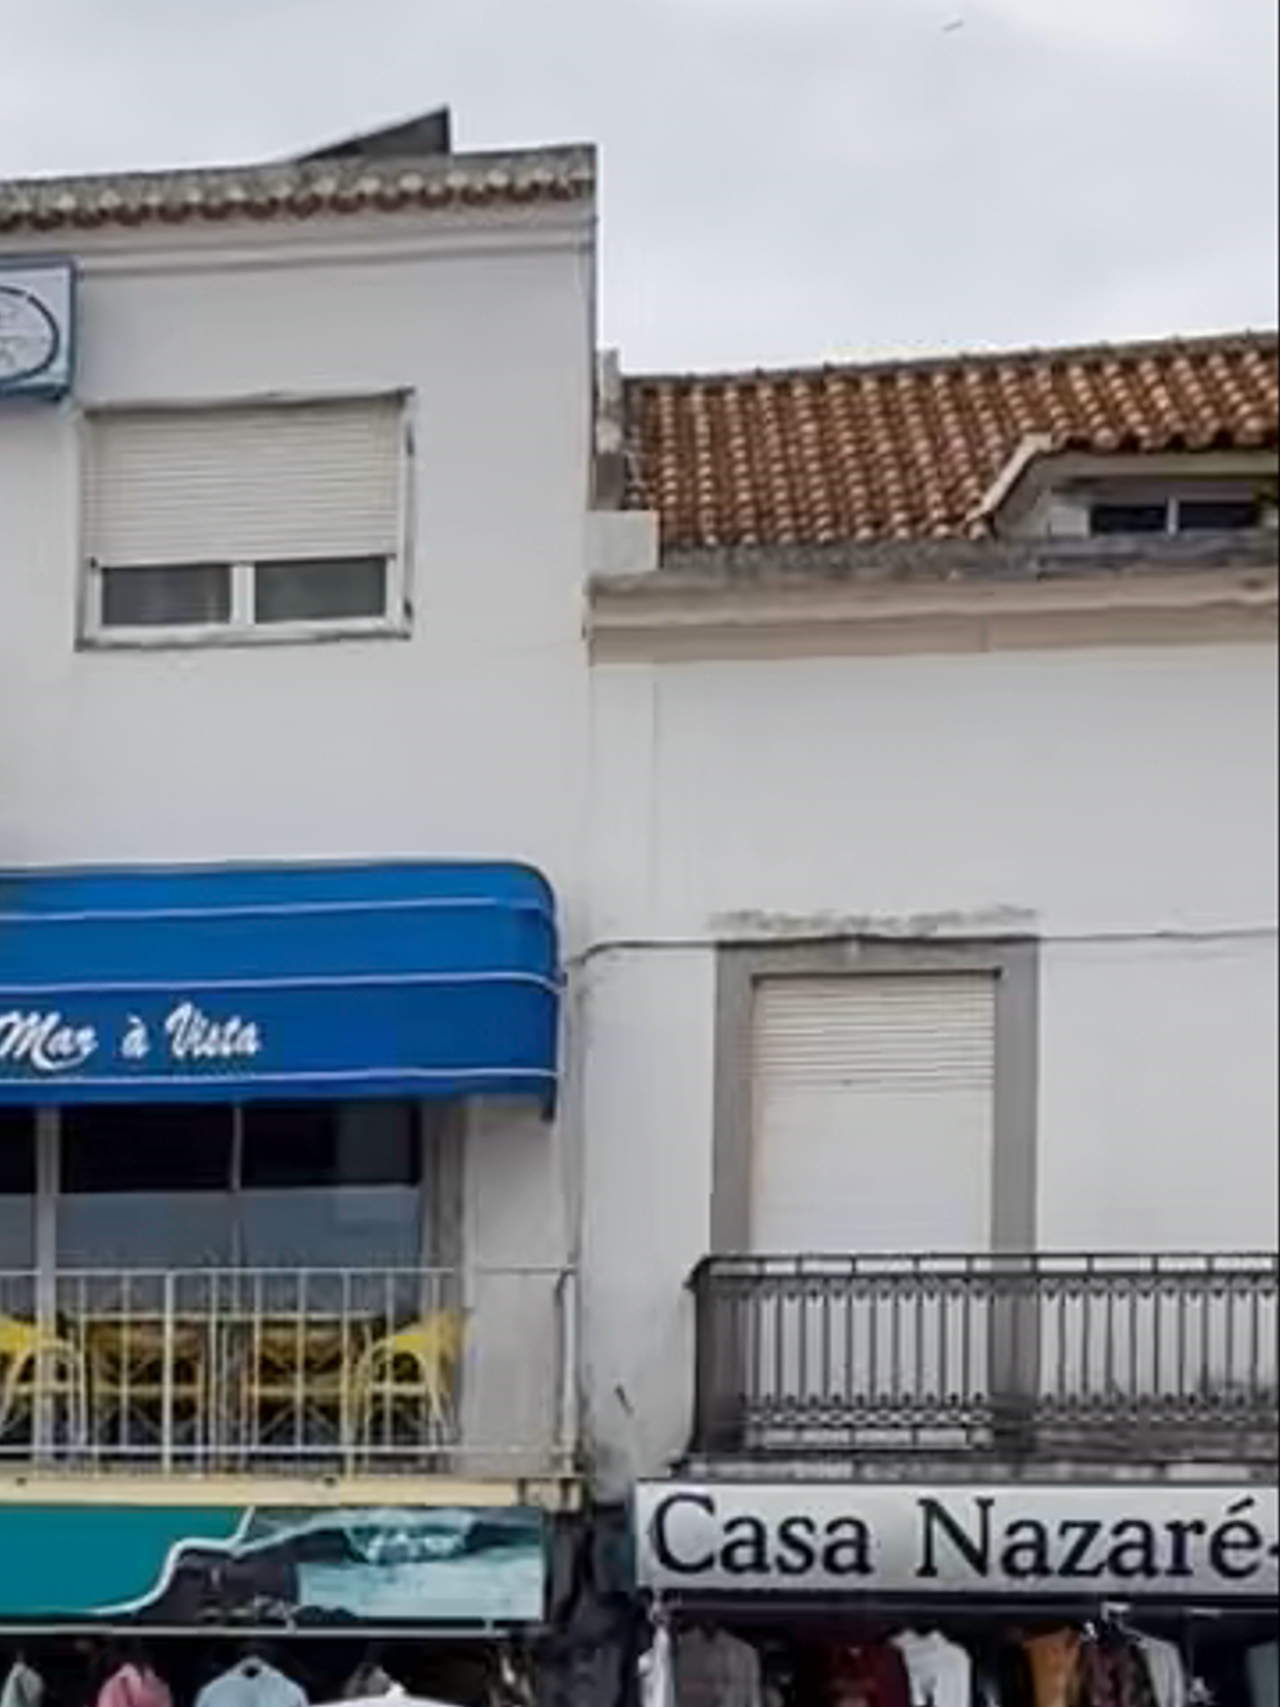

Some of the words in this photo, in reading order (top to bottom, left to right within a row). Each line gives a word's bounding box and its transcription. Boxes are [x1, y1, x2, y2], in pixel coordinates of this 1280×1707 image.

[122, 1013, 151, 1059] à
[165, 1001, 261, 1060] Vista
[652, 1492, 874, 1577] Casa
